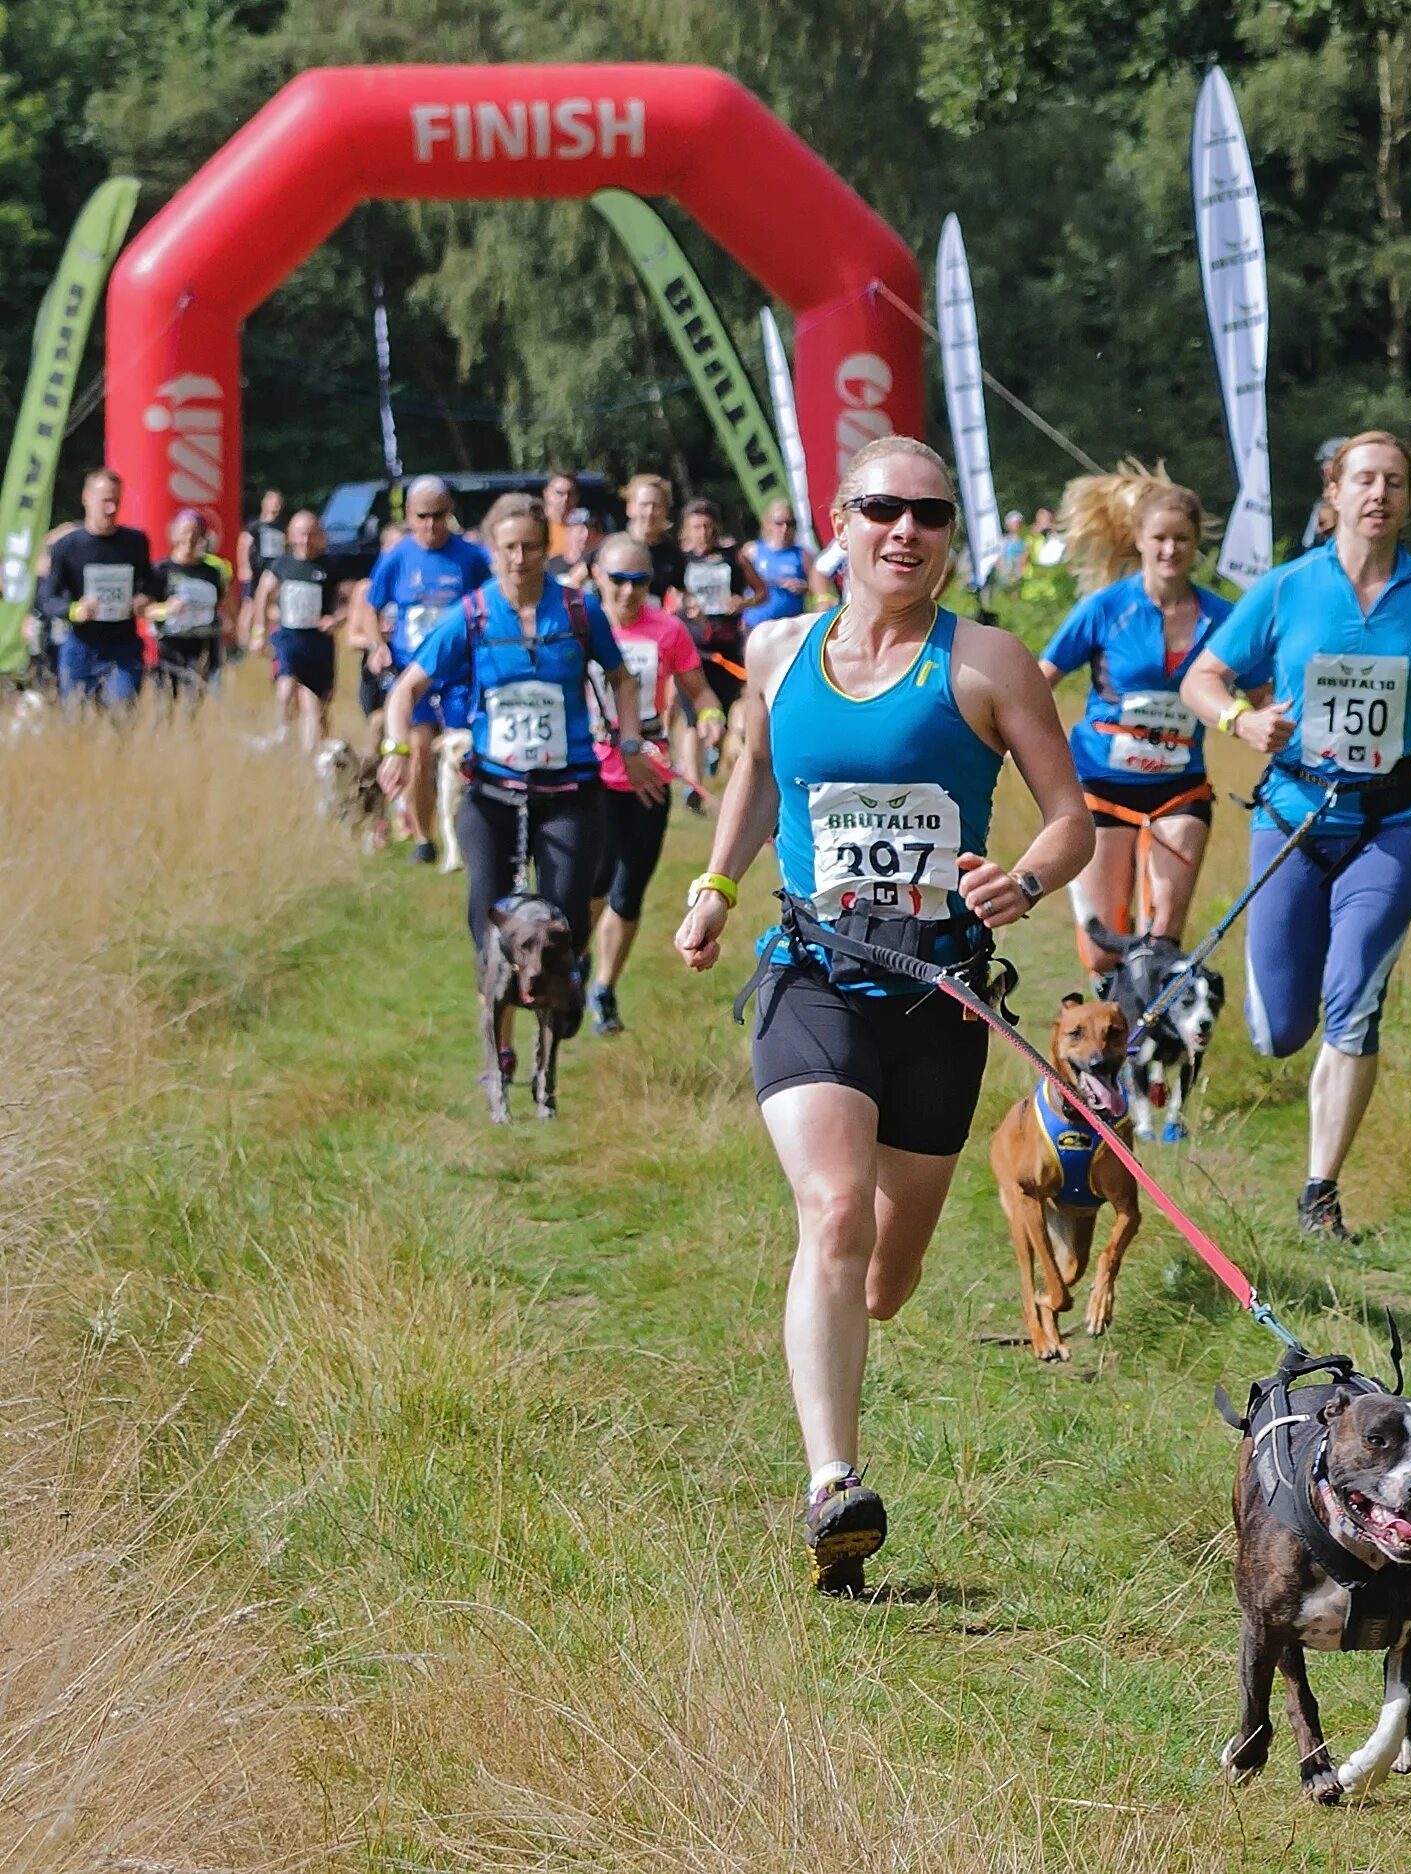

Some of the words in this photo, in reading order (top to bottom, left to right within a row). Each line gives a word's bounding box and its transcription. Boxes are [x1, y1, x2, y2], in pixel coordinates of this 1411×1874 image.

[412, 96, 646, 163] FINISH
[503, 712, 553, 742] 315
[1322, 696, 1388, 736] 150
[828, 812, 941, 830] BRUTAL10
